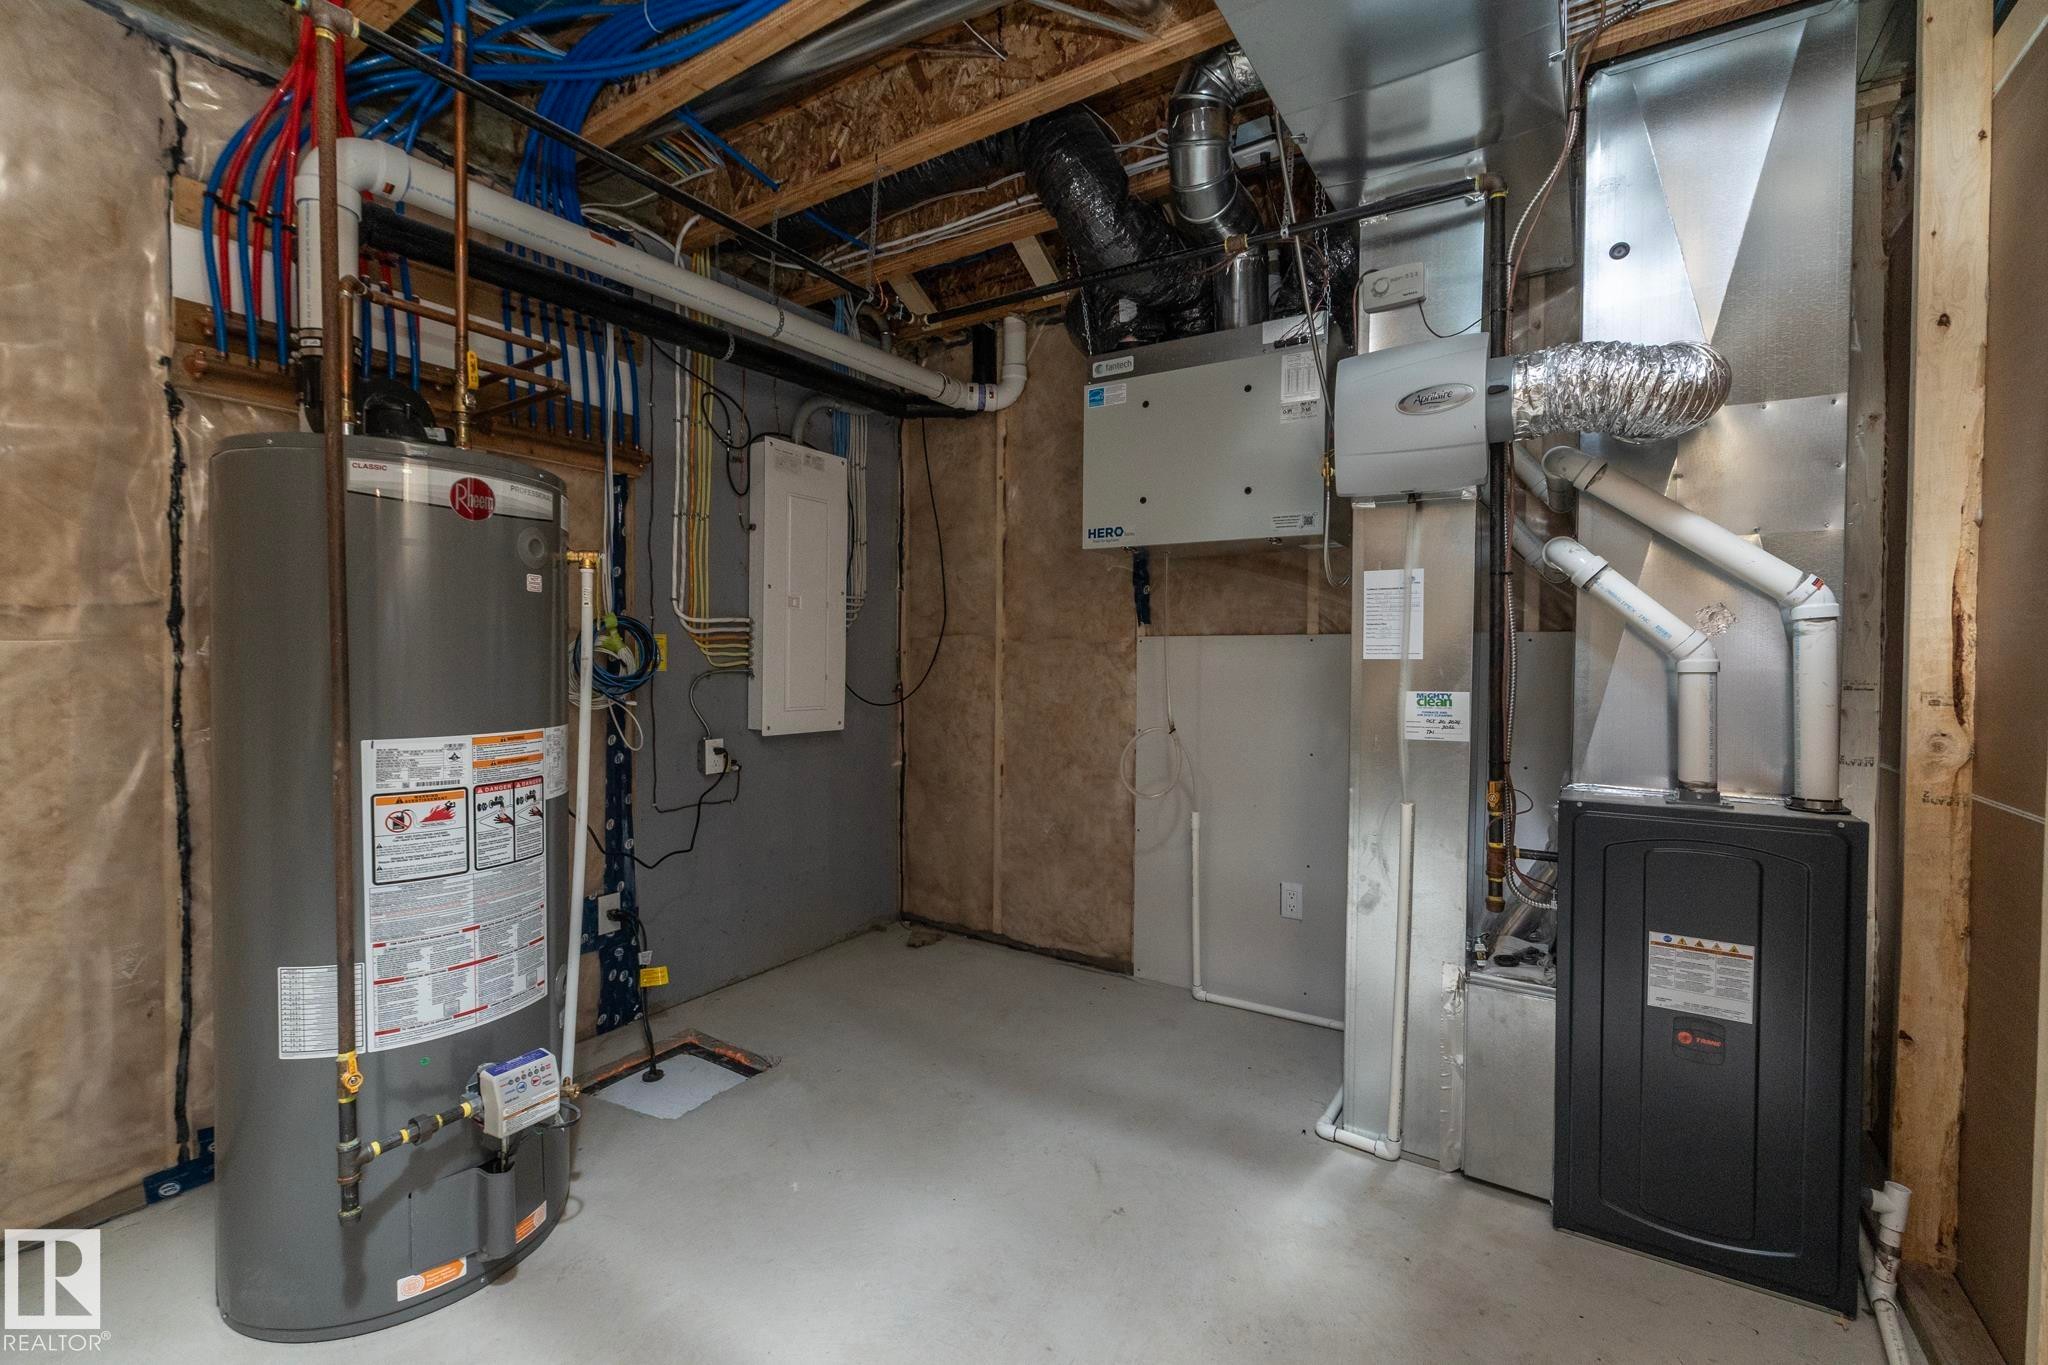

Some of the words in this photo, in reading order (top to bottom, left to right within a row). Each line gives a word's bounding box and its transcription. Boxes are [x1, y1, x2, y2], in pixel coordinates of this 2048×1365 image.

[1106, 360, 1133, 371] fantech
[1413, 390, 1454, 405] Aprilaire
[352, 462, 387, 472] CLASSIC
[455, 478, 494, 514] Rheem
[1088, 526, 1124, 539] HERO
[1416, 696, 1453, 707] clean
[484, 783, 512, 792] DANGER
[521, 778, 542, 787] DANGER
